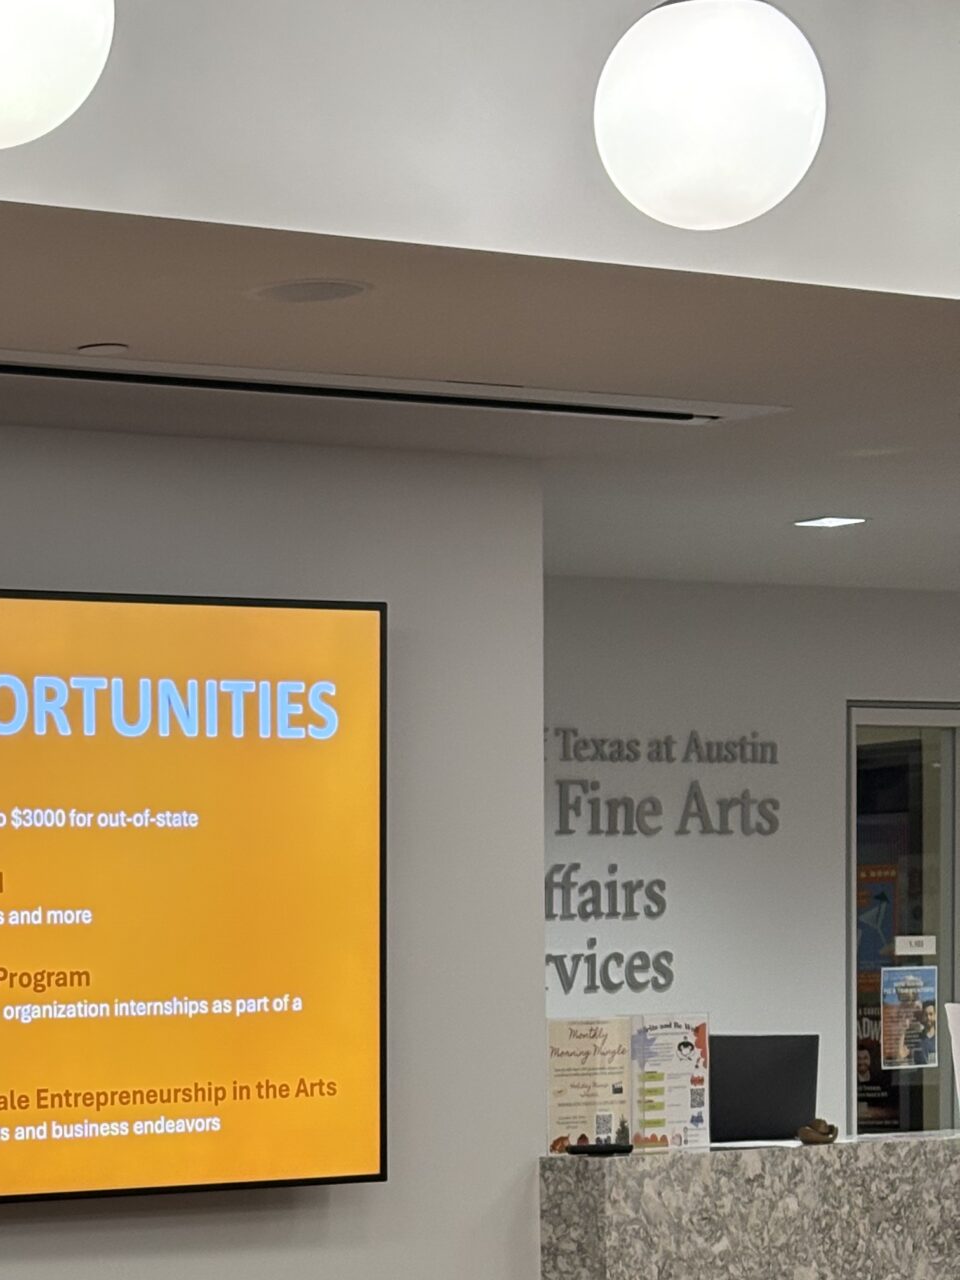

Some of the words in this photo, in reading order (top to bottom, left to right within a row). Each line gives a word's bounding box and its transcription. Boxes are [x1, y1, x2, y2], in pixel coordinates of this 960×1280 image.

[554, 727, 641, 763] Texas
[647, 734, 676, 763] at
[681, 729, 779, 764] Austin
[11, 807, 67, 829] $3000
[68, 809, 94, 827] for
[97, 809, 199, 828] out-of-state
[554, 779, 663, 837] Fine
[675, 780, 780, 836] Arts
[8, 907, 42, 925] and
[46, 909, 92, 924] more
[3, 1001, 110, 1023] organization
[114, 997, 208, 1017] internships
[212, 1000, 232, 1013] as
[235, 997, 269, 1016] part
[272, 994, 289, 1011] of
[291, 997, 302, 1011] a
[568, 1026, 608, 1047] Monthly
[550, 1045, 591, 1065] Morning
[37, 1082, 226, 1111] Entrepreneurship
[233, 1080, 250, 1100] in
[256, 1079, 290, 1099] the
[295, 1078, 337, 1097] Arts
[14, 1122, 47, 1140] and
[51, 1120, 129, 1139] business
[133, 1116, 220, 1135] endeavors
